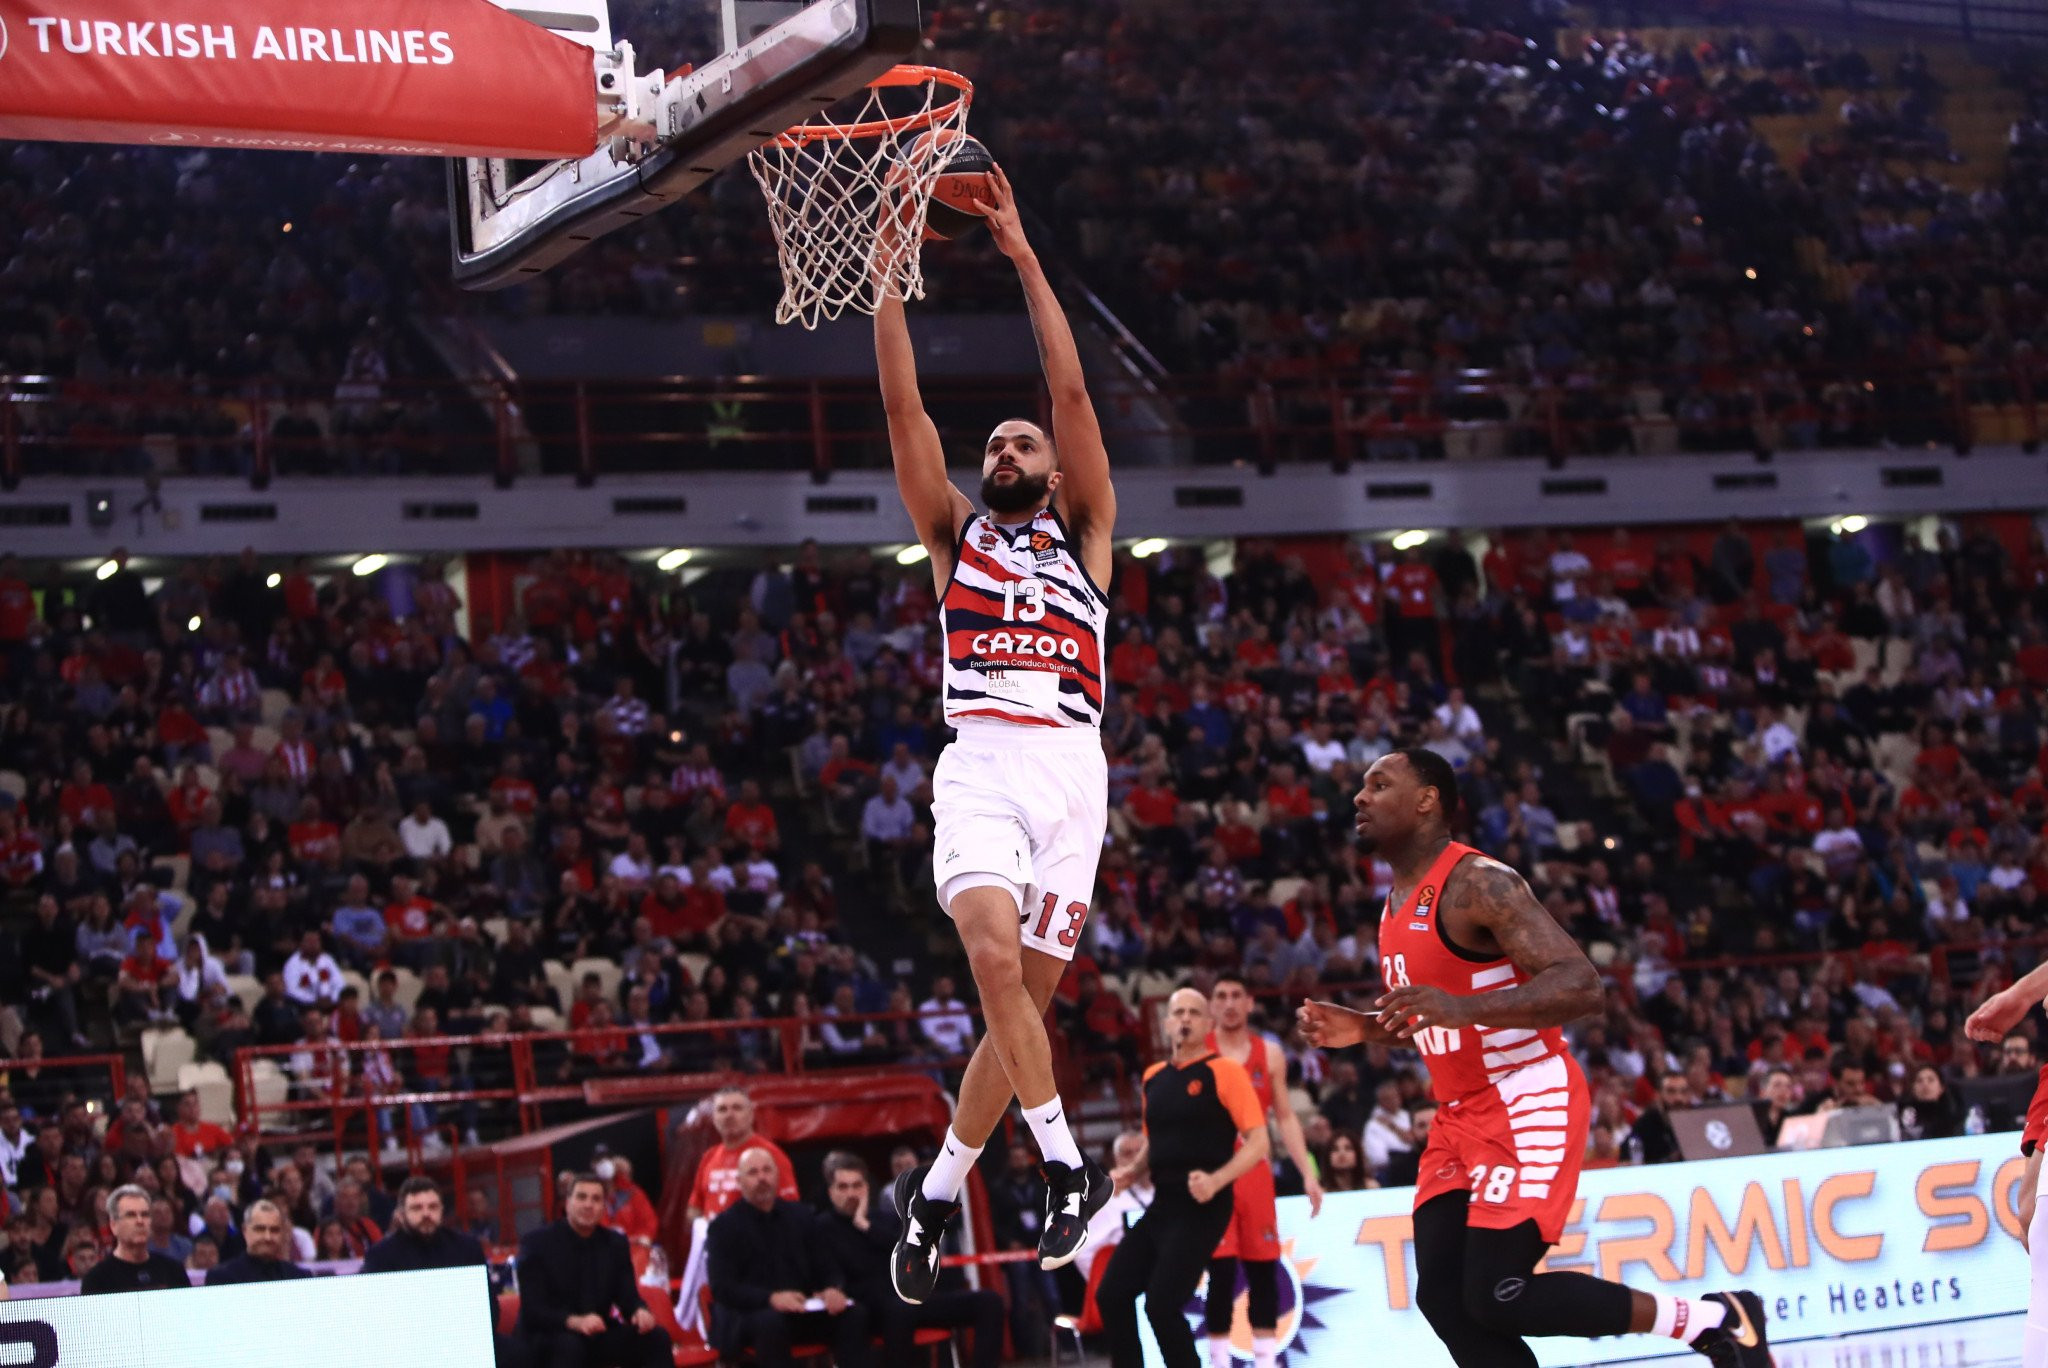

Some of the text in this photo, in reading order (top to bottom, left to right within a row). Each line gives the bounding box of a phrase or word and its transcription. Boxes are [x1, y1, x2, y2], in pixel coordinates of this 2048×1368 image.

[28, 17, 455, 65] TURKISH AIRLINES
[212, 136, 444, 154] TURKISH AIRLINES
[1002, 577, 1046, 622] 13
[970, 659, 1010, 669] Encuentra.
[972, 632, 1080, 660] CAZOO
[988, 670, 1007, 680] ETL
[988, 680, 1021, 688] GLOBAL
[1034, 891, 1089, 948] 13
[1382, 952, 1411, 992] 28
[1355, 1170, 1886, 1310] TERMIC
[1828, 1275, 1962, 1315] Heaters
